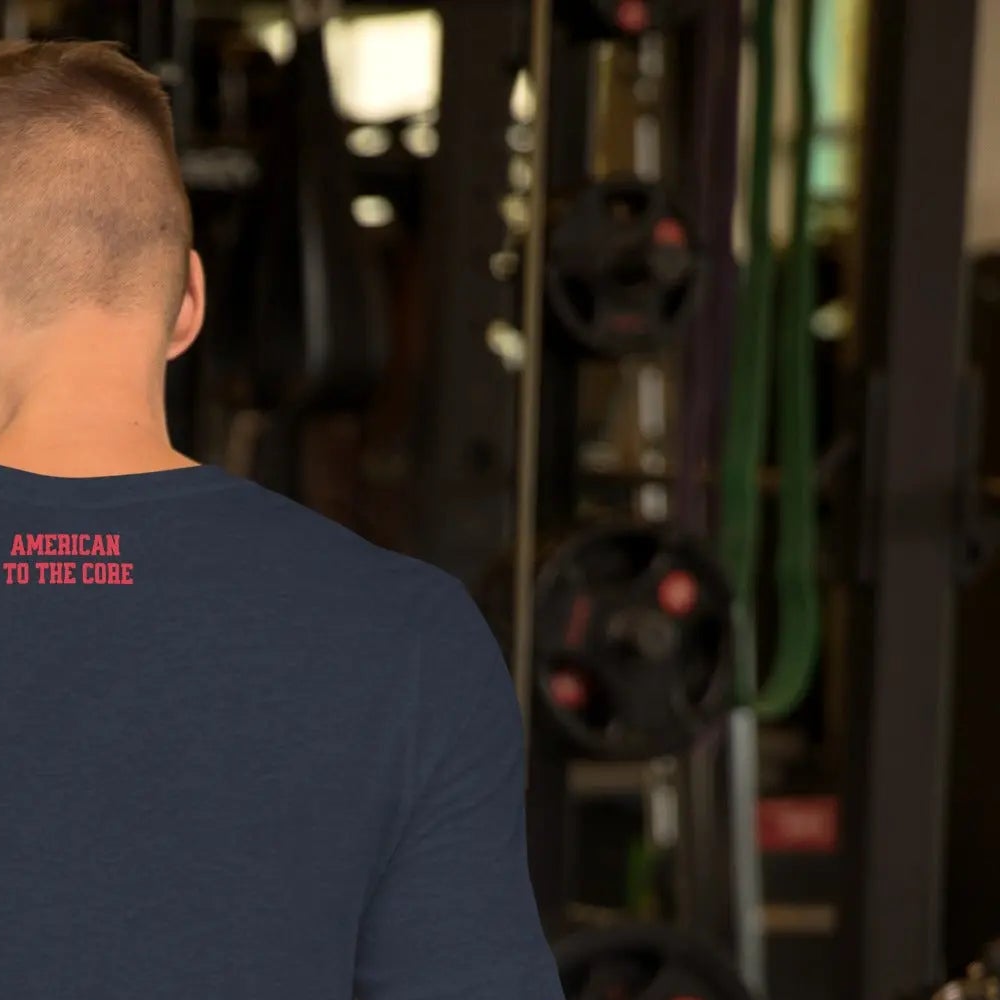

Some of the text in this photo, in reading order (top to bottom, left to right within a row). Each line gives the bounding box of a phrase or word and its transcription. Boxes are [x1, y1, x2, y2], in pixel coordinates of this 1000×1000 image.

[10, 533, 121, 556] AMERICAN
[3, 562, 134, 585] TO THE CORE
